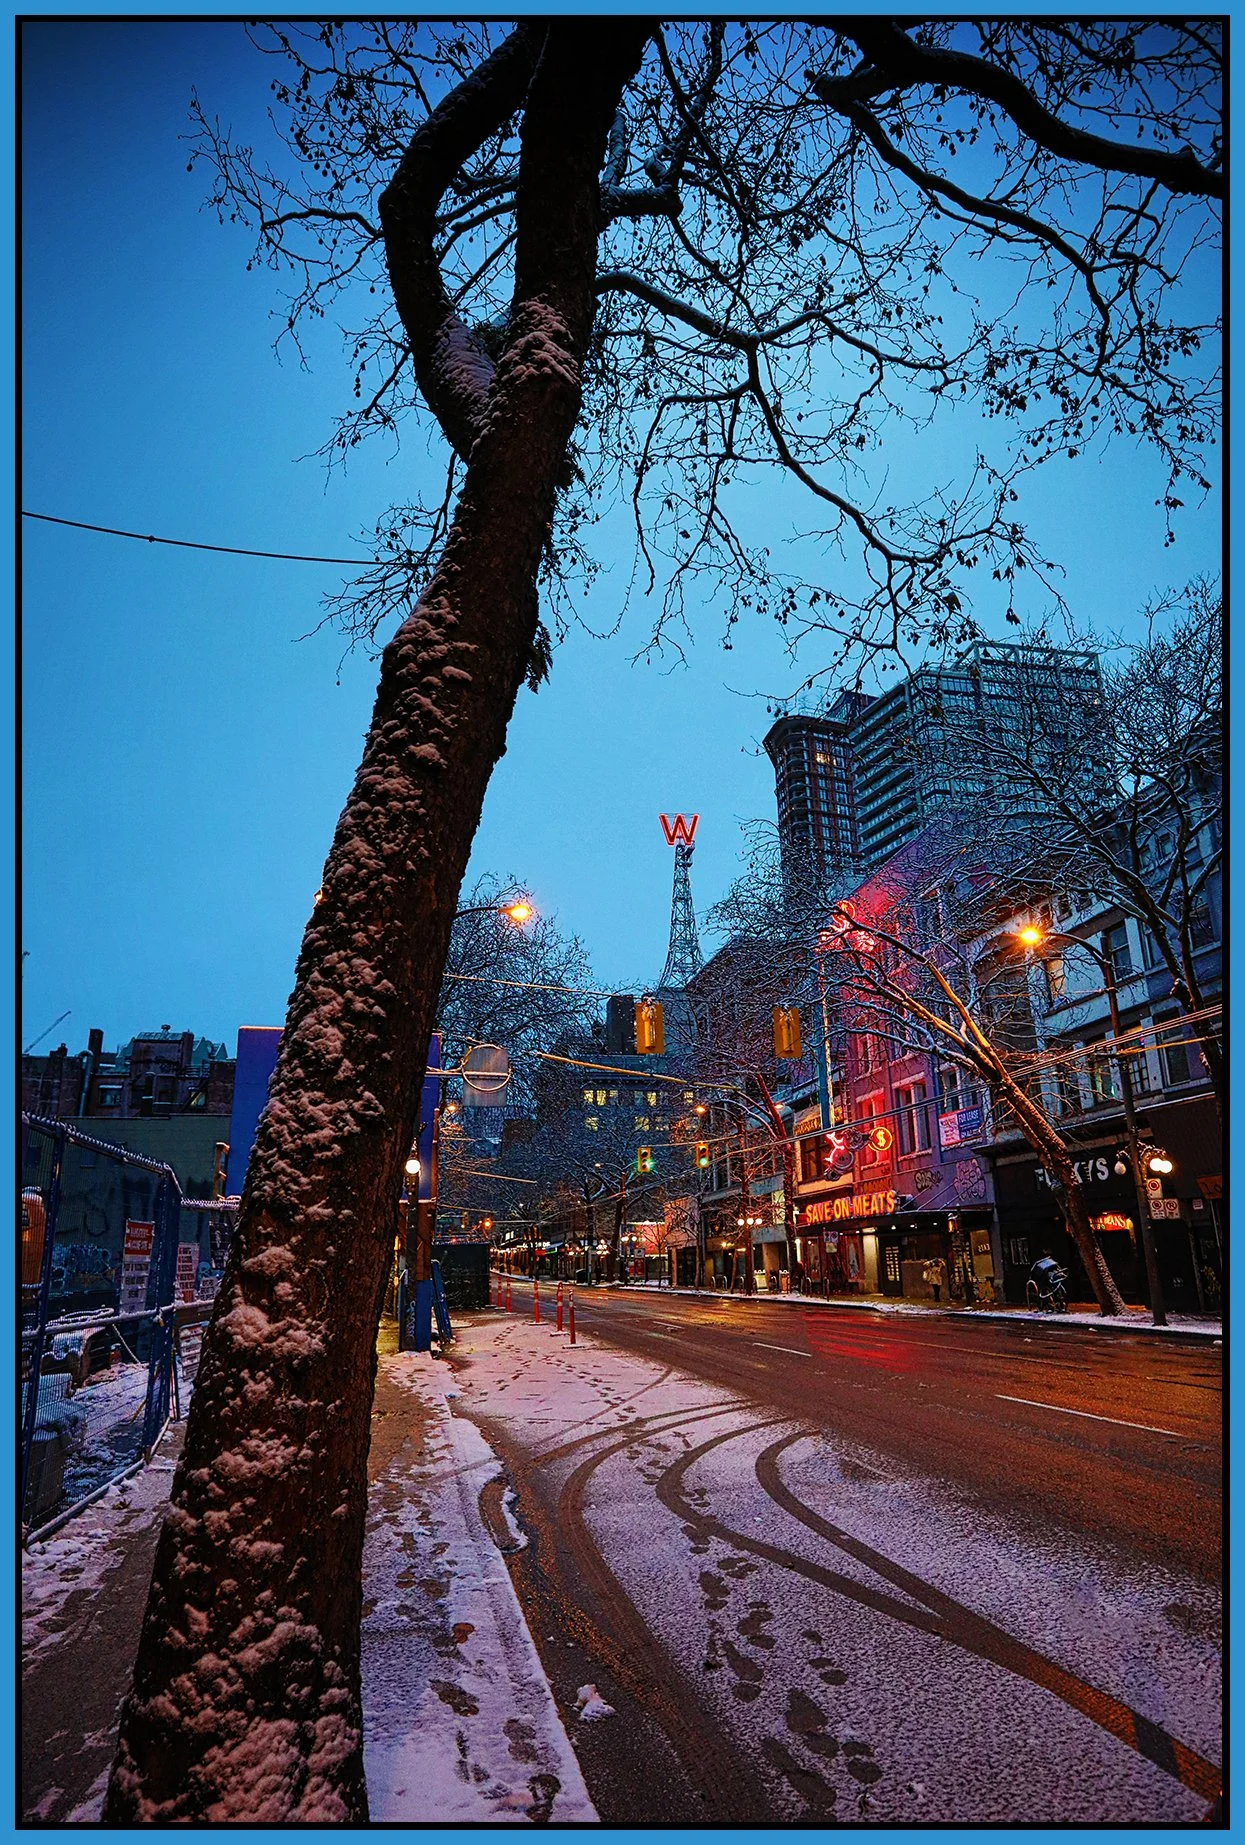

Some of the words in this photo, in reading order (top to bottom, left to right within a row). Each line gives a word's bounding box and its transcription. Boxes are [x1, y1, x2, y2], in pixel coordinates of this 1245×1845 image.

[658, 813, 699, 846] W
[966, 1109, 979, 1121] LEASE
[806, 1200, 832, 1224] SAVE
[833, 1198, 850, 1219] ON
[852, 1190, 895, 1216] MEATS
